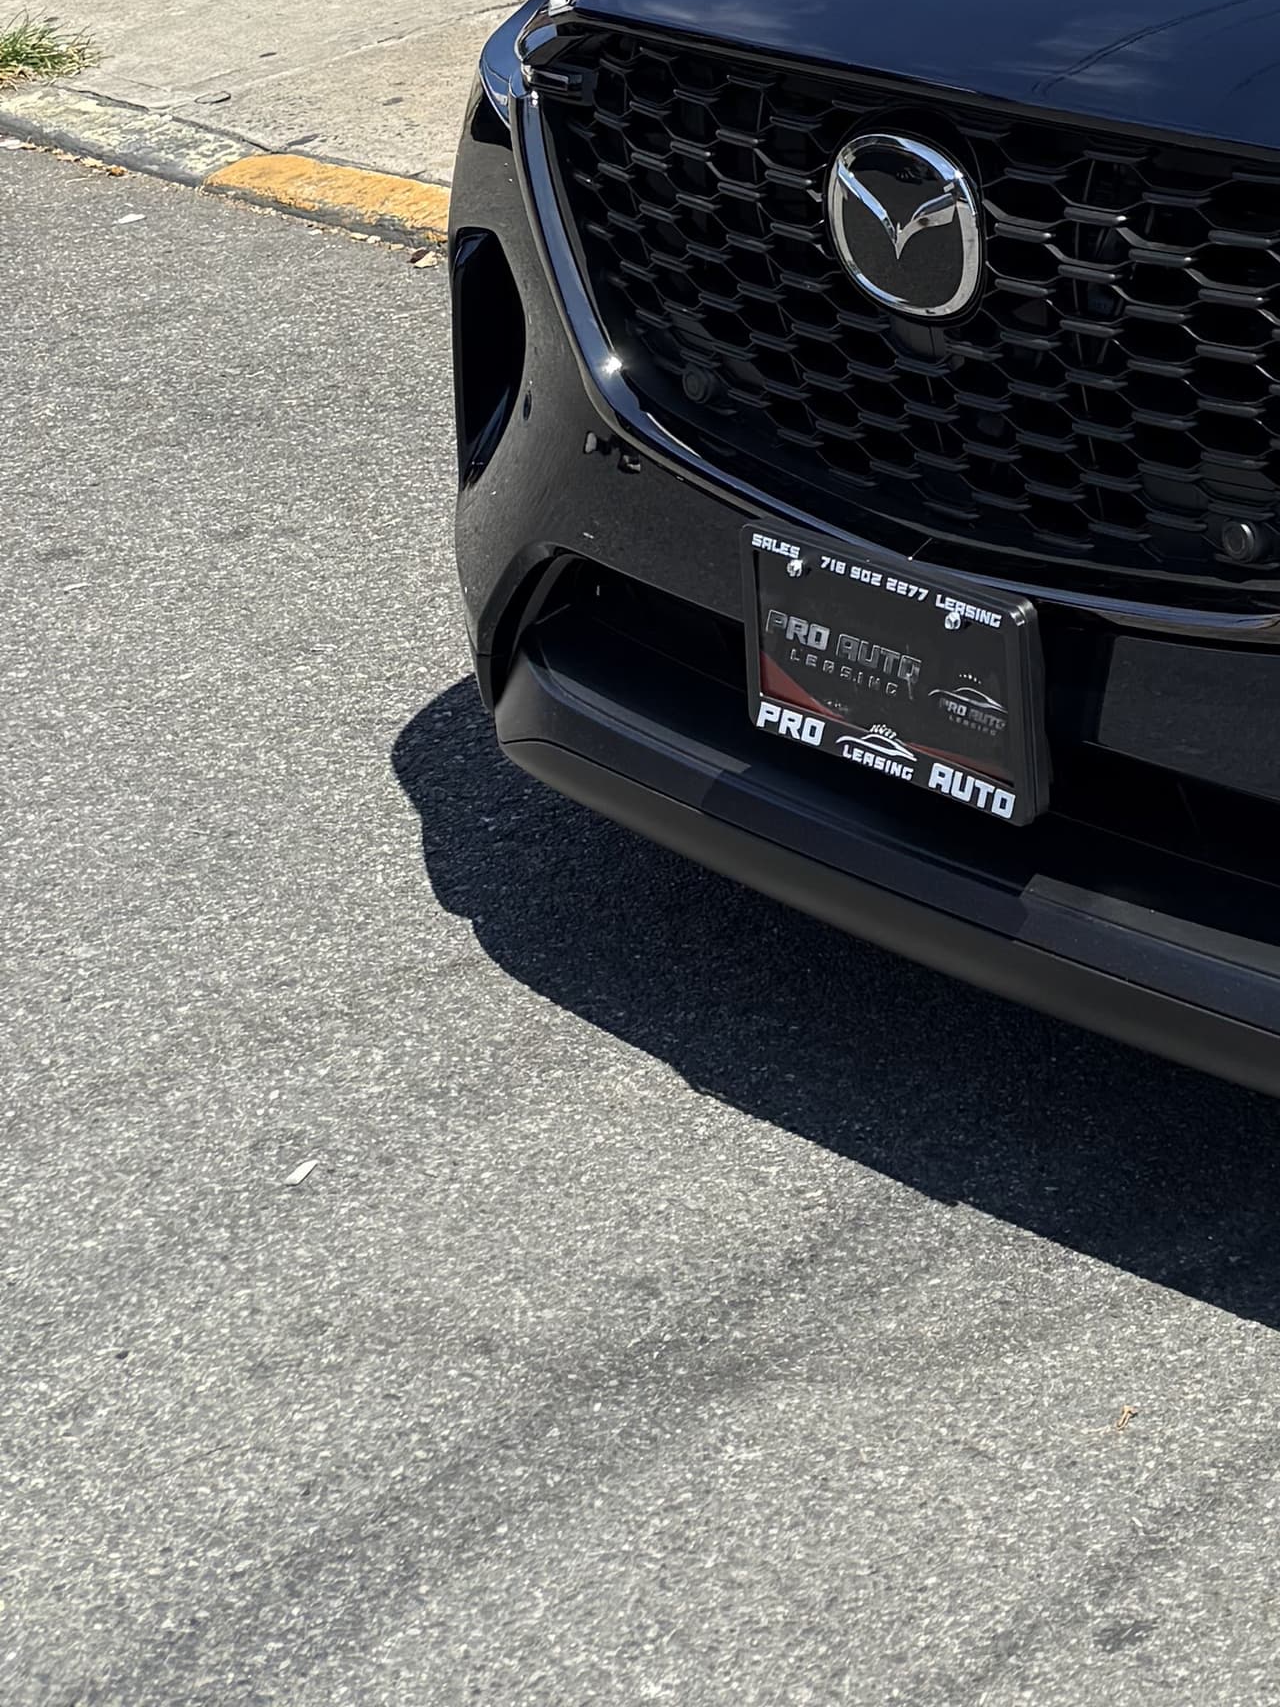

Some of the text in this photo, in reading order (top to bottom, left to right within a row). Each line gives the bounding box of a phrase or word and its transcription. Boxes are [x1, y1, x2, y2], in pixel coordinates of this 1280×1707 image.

[751, 532, 1003, 629] SALES 718 902 2277 LEASING
[764, 608, 923, 685] PRO AUTO
[789, 647, 899, 697] LEASING
[755, 700, 826, 748] PRO
[939, 697, 1007, 730] PRO AUTO
[842, 743, 915, 782] LEASING
[927, 761, 1017, 821] AUTO
